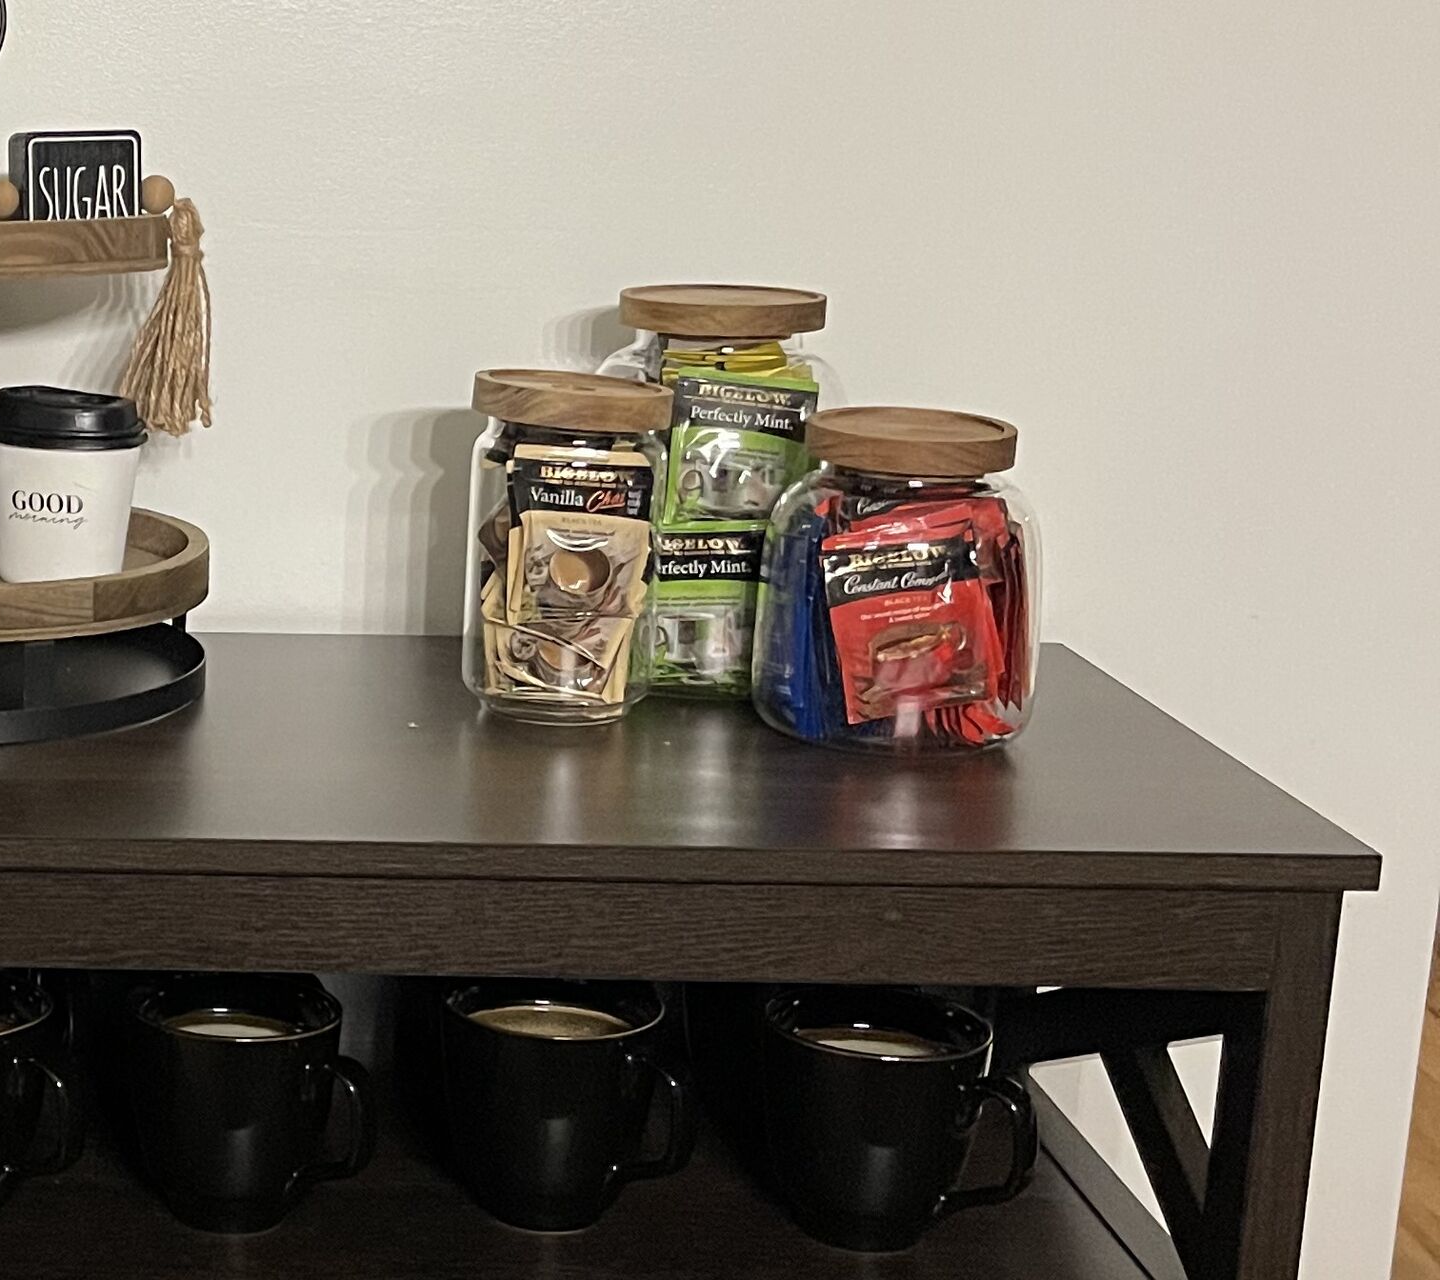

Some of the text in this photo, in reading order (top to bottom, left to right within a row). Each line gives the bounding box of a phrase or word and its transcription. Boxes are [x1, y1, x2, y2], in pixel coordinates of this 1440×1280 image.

[38, 164, 128, 221] SUGAR
[690, 405, 752, 428] Perfectly
[11, 489, 84, 515] GOOD
[531, 486, 584, 507] Vanilla
[658, 560, 708, 578] rfectly
[843, 574, 898, 596] Constant
